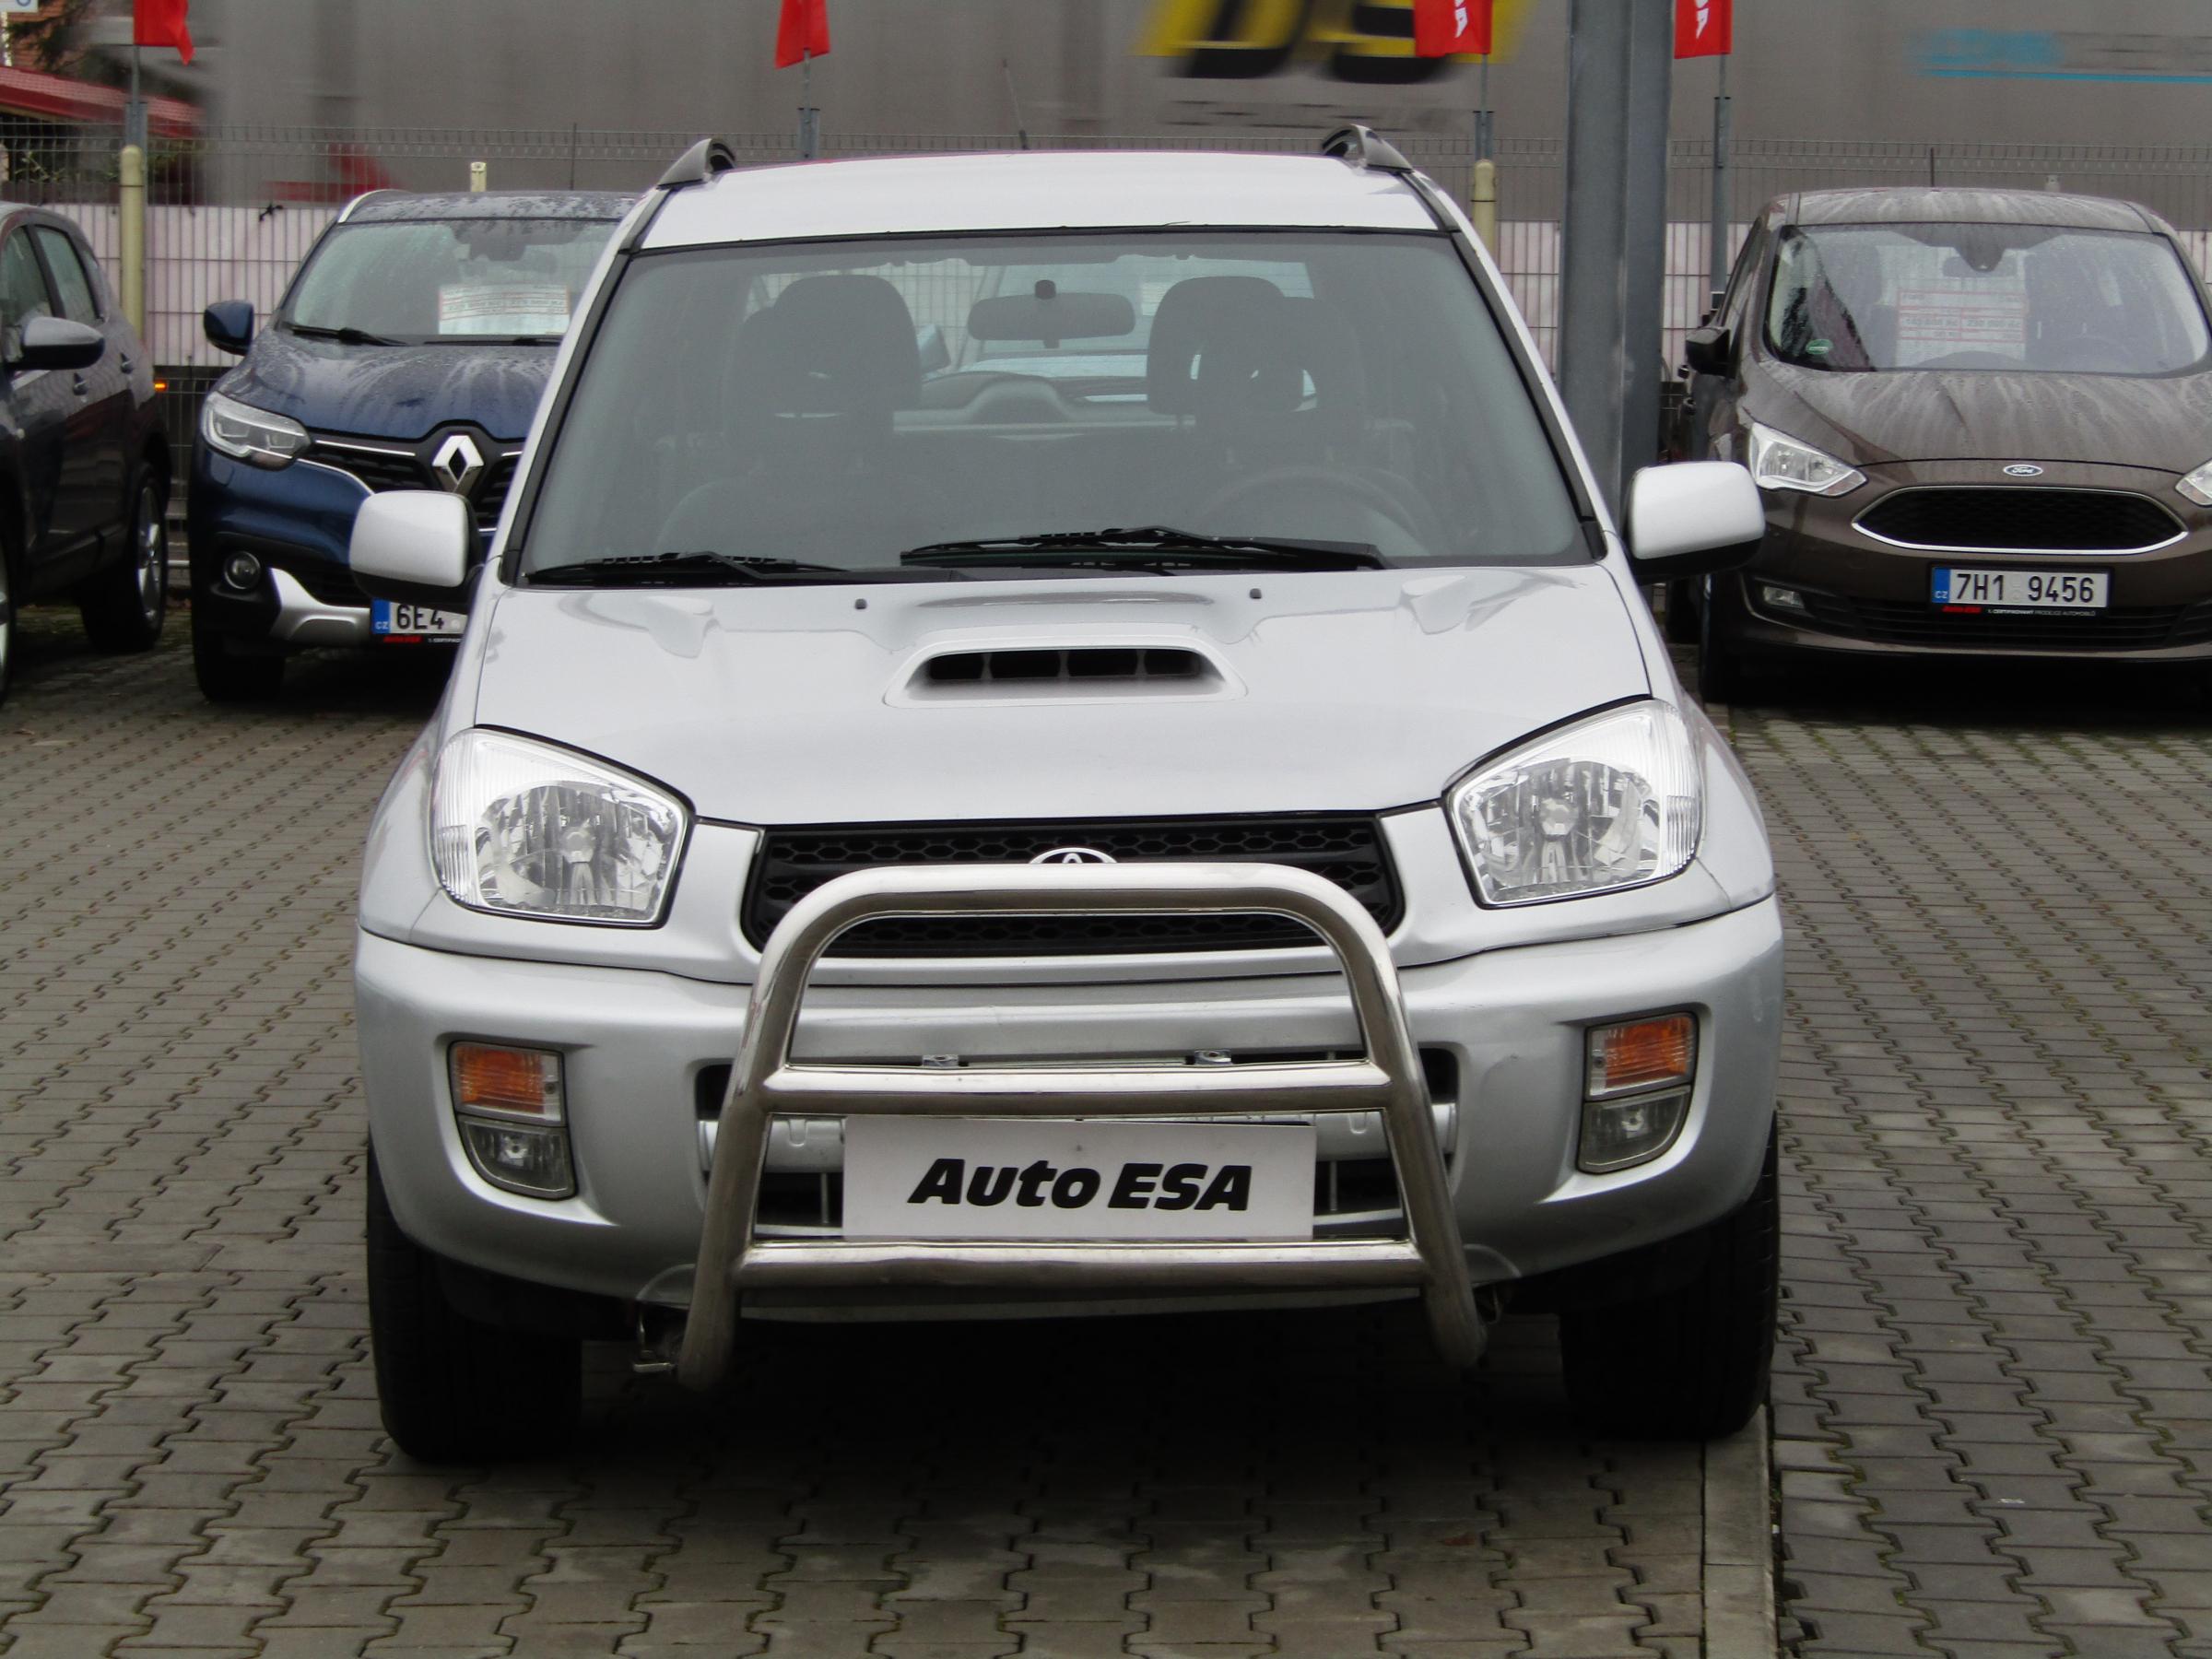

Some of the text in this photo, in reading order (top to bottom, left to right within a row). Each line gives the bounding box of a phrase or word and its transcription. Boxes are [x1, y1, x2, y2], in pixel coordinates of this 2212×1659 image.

[1936, 591, 1947, 599] CZ
[1957, 573, 2094, 604] 7H1 9456
[374, 621, 389, 629] CZ
[396, 604, 444, 629] 6E4
[907, 1158, 1253, 1211] Auto ESA
